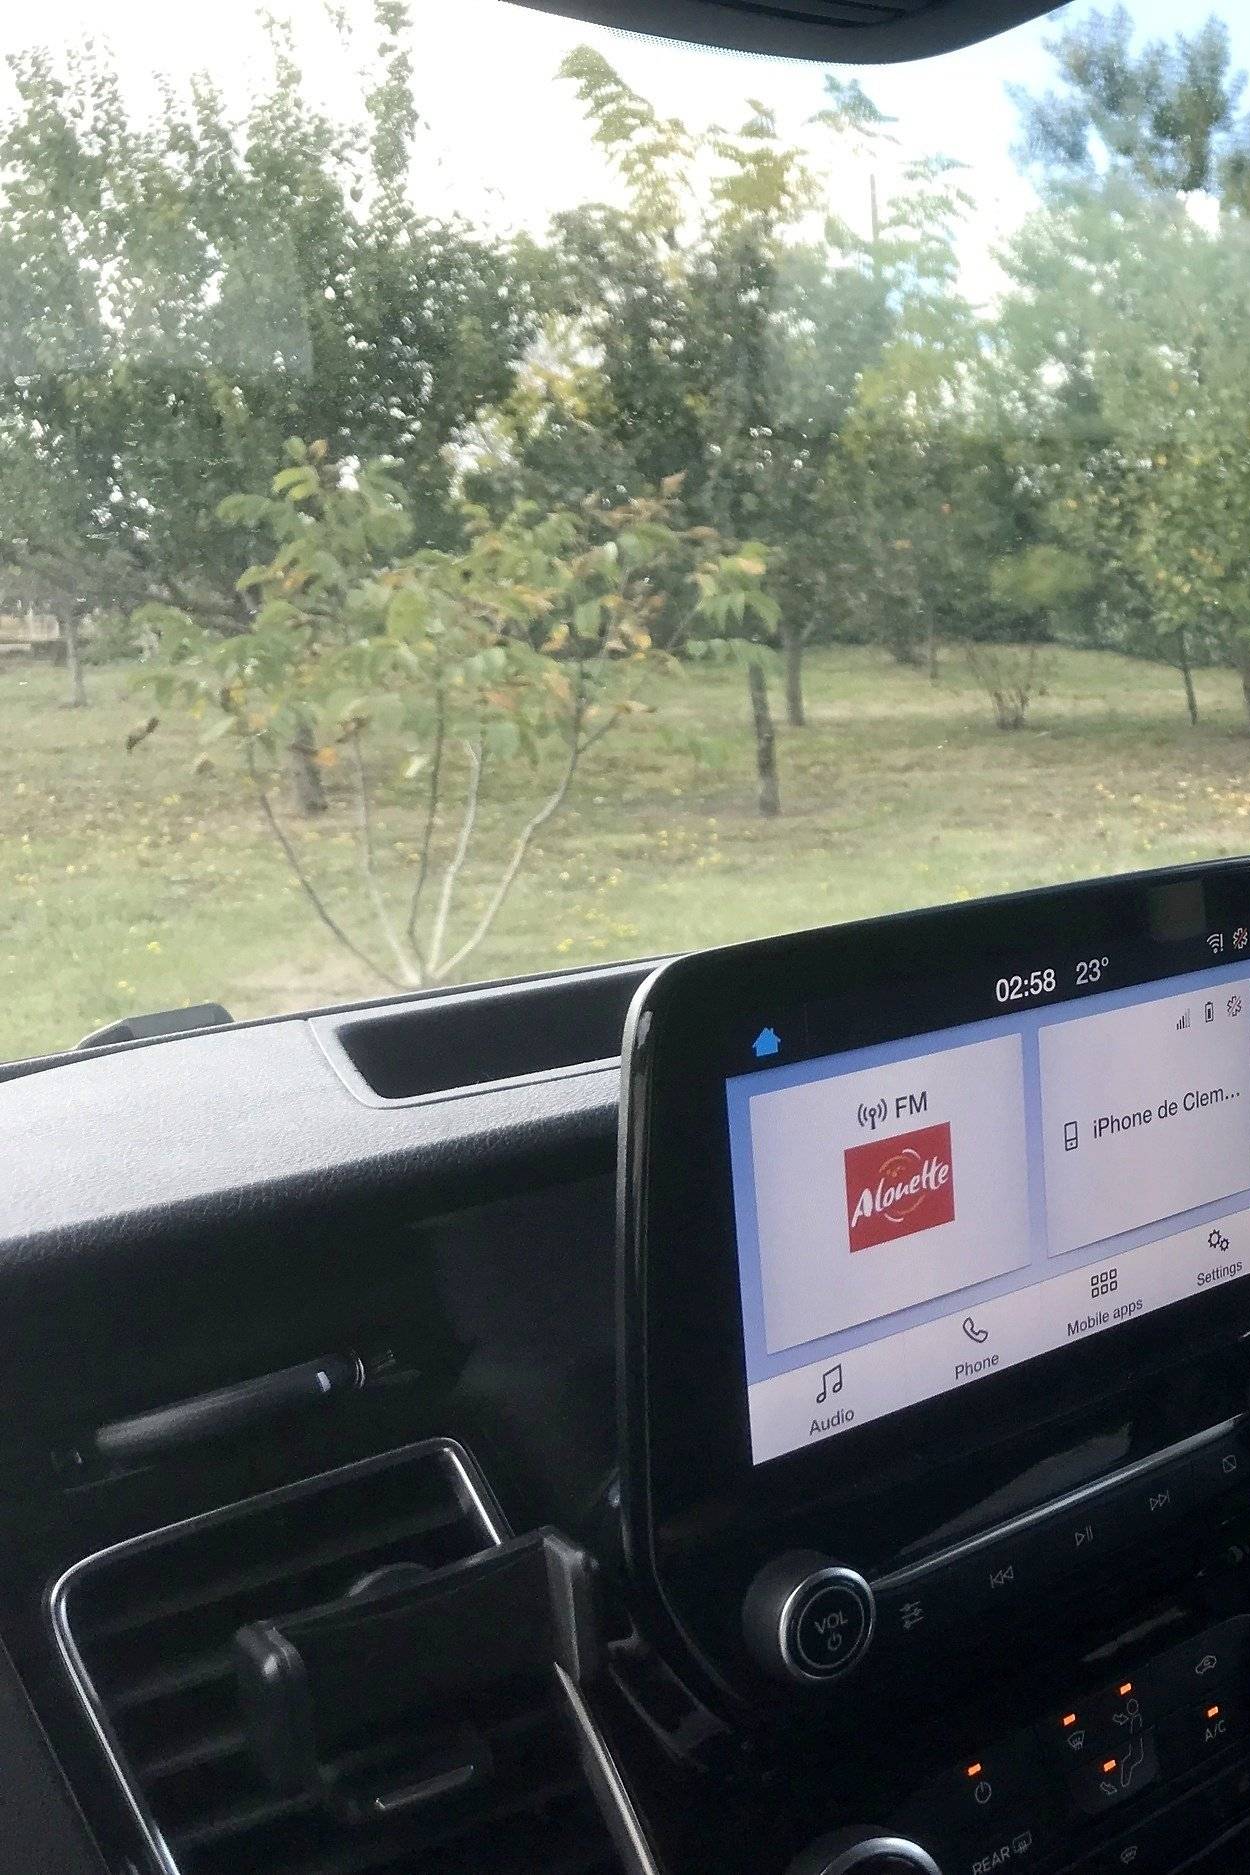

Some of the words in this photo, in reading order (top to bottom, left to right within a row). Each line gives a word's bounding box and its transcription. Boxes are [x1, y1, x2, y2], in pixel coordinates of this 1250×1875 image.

[995, 968, 1057, 1004] 02:58
[895, 1091, 929, 1119] FM
[1093, 1108, 1153, 1139] iPhone
[1157, 1099, 1179, 1120] de
[851, 1156, 951, 1228] Alouette
[1196, 1260, 1243, 1288] Settings
[1067, 1311, 1110, 1337] Mobile
[1113, 1298, 1144, 1322] apps
[954, 1353, 1000, 1380] Phone
[809, 1407, 855, 1436] Audio
[813, 1609, 849, 1636] VOL
[1204, 1719, 1227, 1744] A/C
[972, 1845, 1011, 1875] REAR
